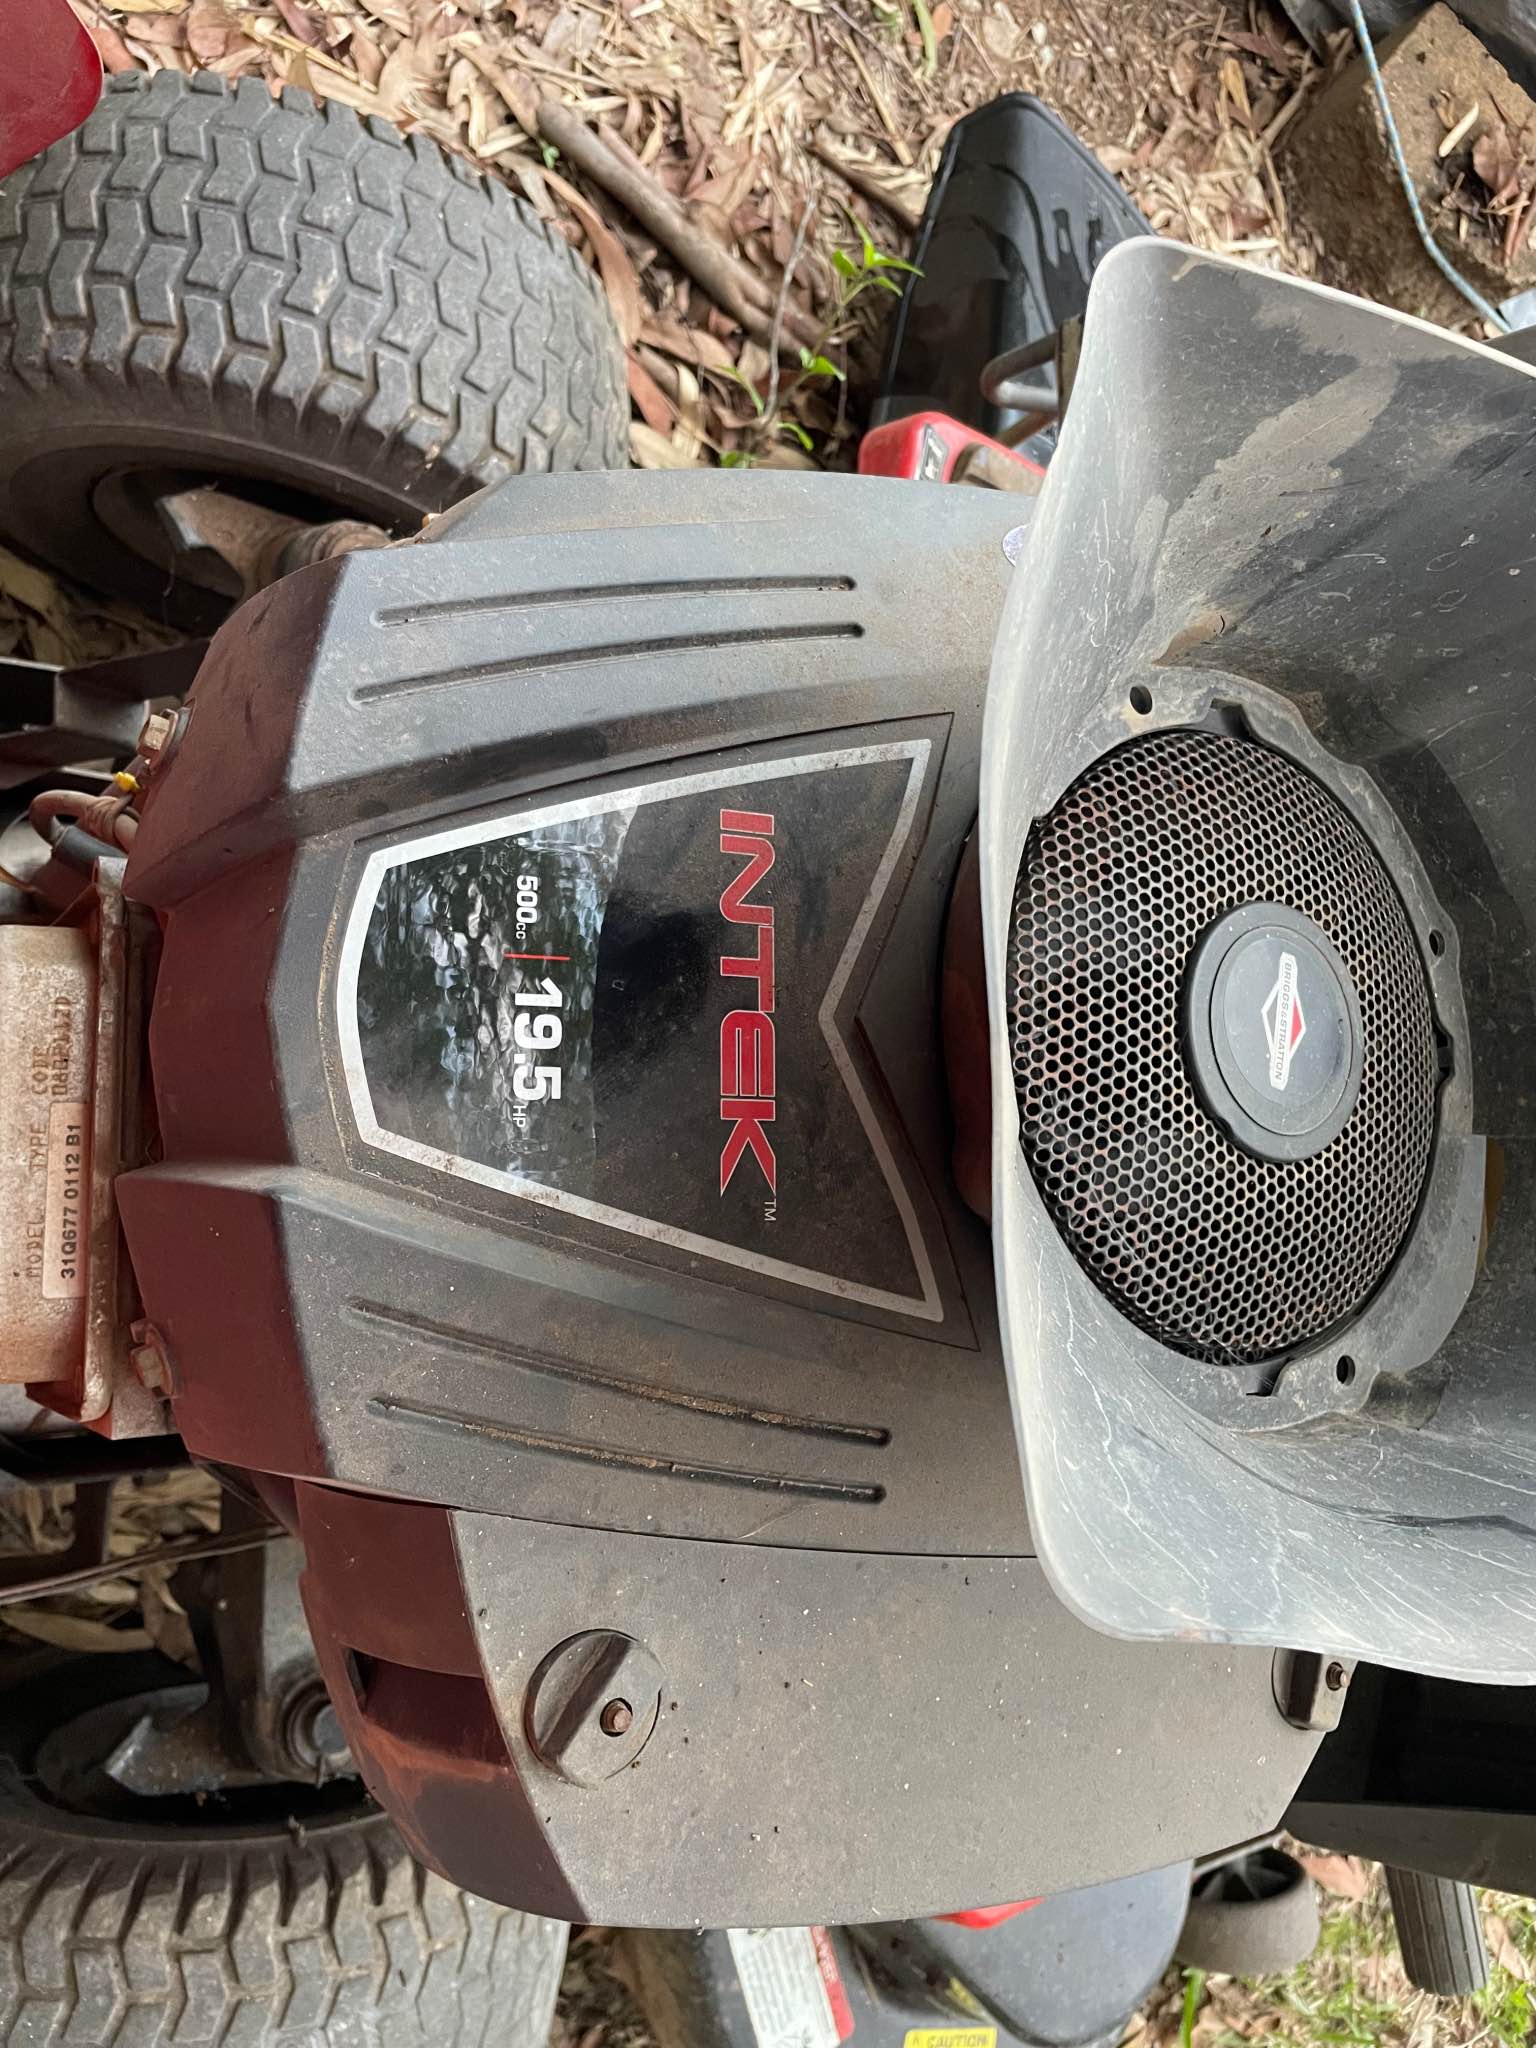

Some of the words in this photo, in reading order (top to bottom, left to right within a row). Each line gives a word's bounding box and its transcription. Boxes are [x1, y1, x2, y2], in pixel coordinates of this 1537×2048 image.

[720, 808, 776, 1197] INTEK
[32, 1046, 49, 1095] CODE
[30, 1123, 47, 1173] TYPE
[66, 1124, 81, 1147] B1
[62, 1154, 79, 1200] 0112
[26, 1215, 45, 1279] MODEL
[61, 1207, 78, 1279] 31Q677
